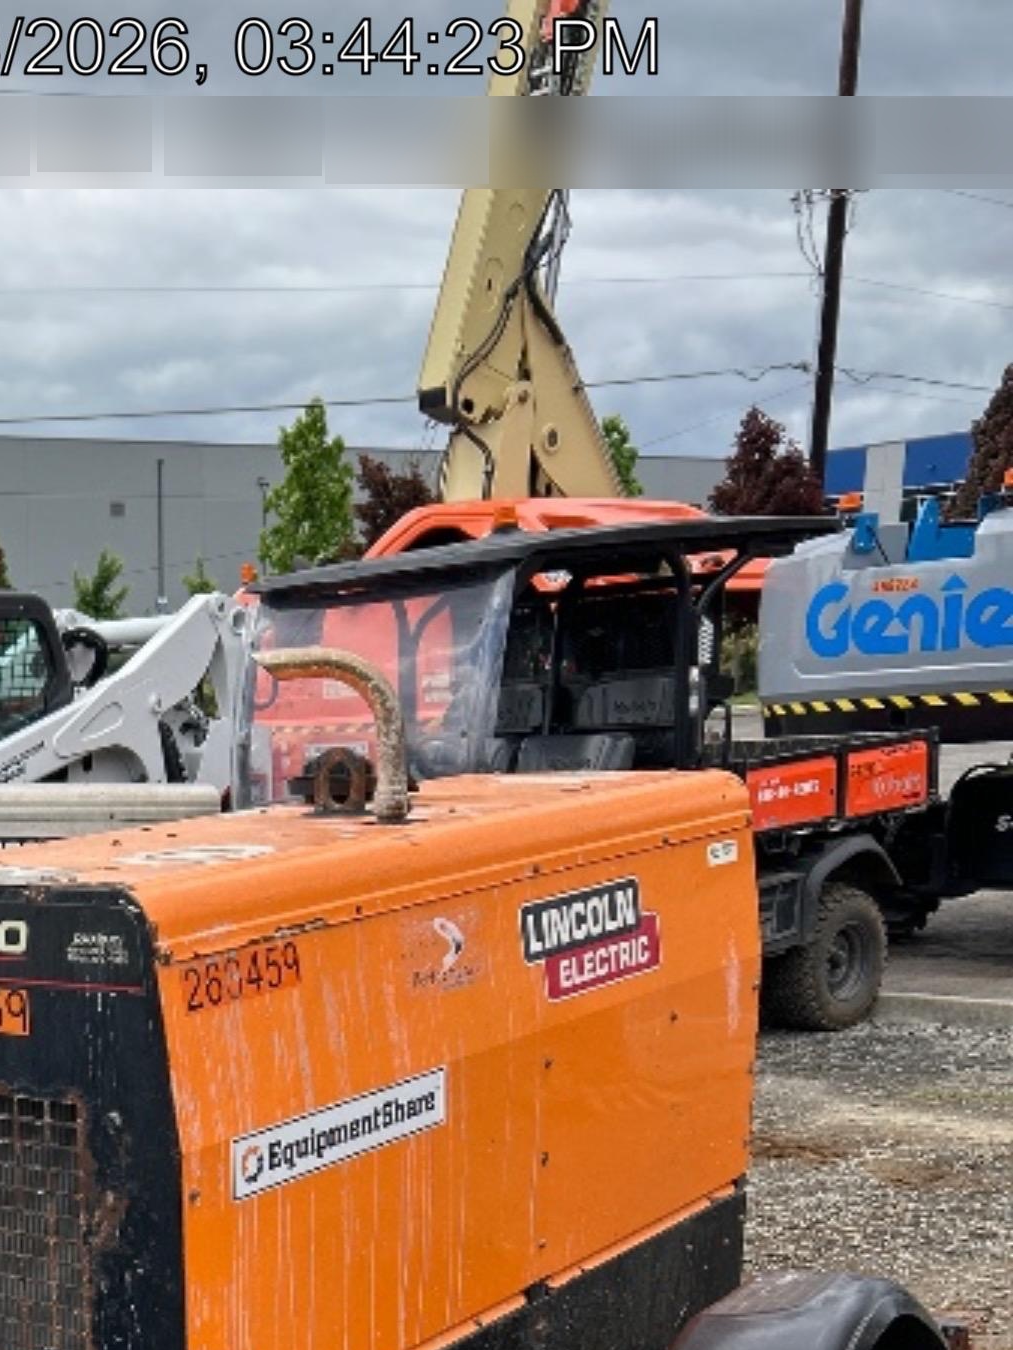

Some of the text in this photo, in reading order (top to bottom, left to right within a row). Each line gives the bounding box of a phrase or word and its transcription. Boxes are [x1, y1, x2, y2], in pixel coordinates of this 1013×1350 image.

[806, 573, 1013, 658] Genie
[526, 887, 636, 954] LINCOLN
[559, 935, 650, 988] ELECTRIC
[268, 1091, 436, 1170] EquipmentShare
